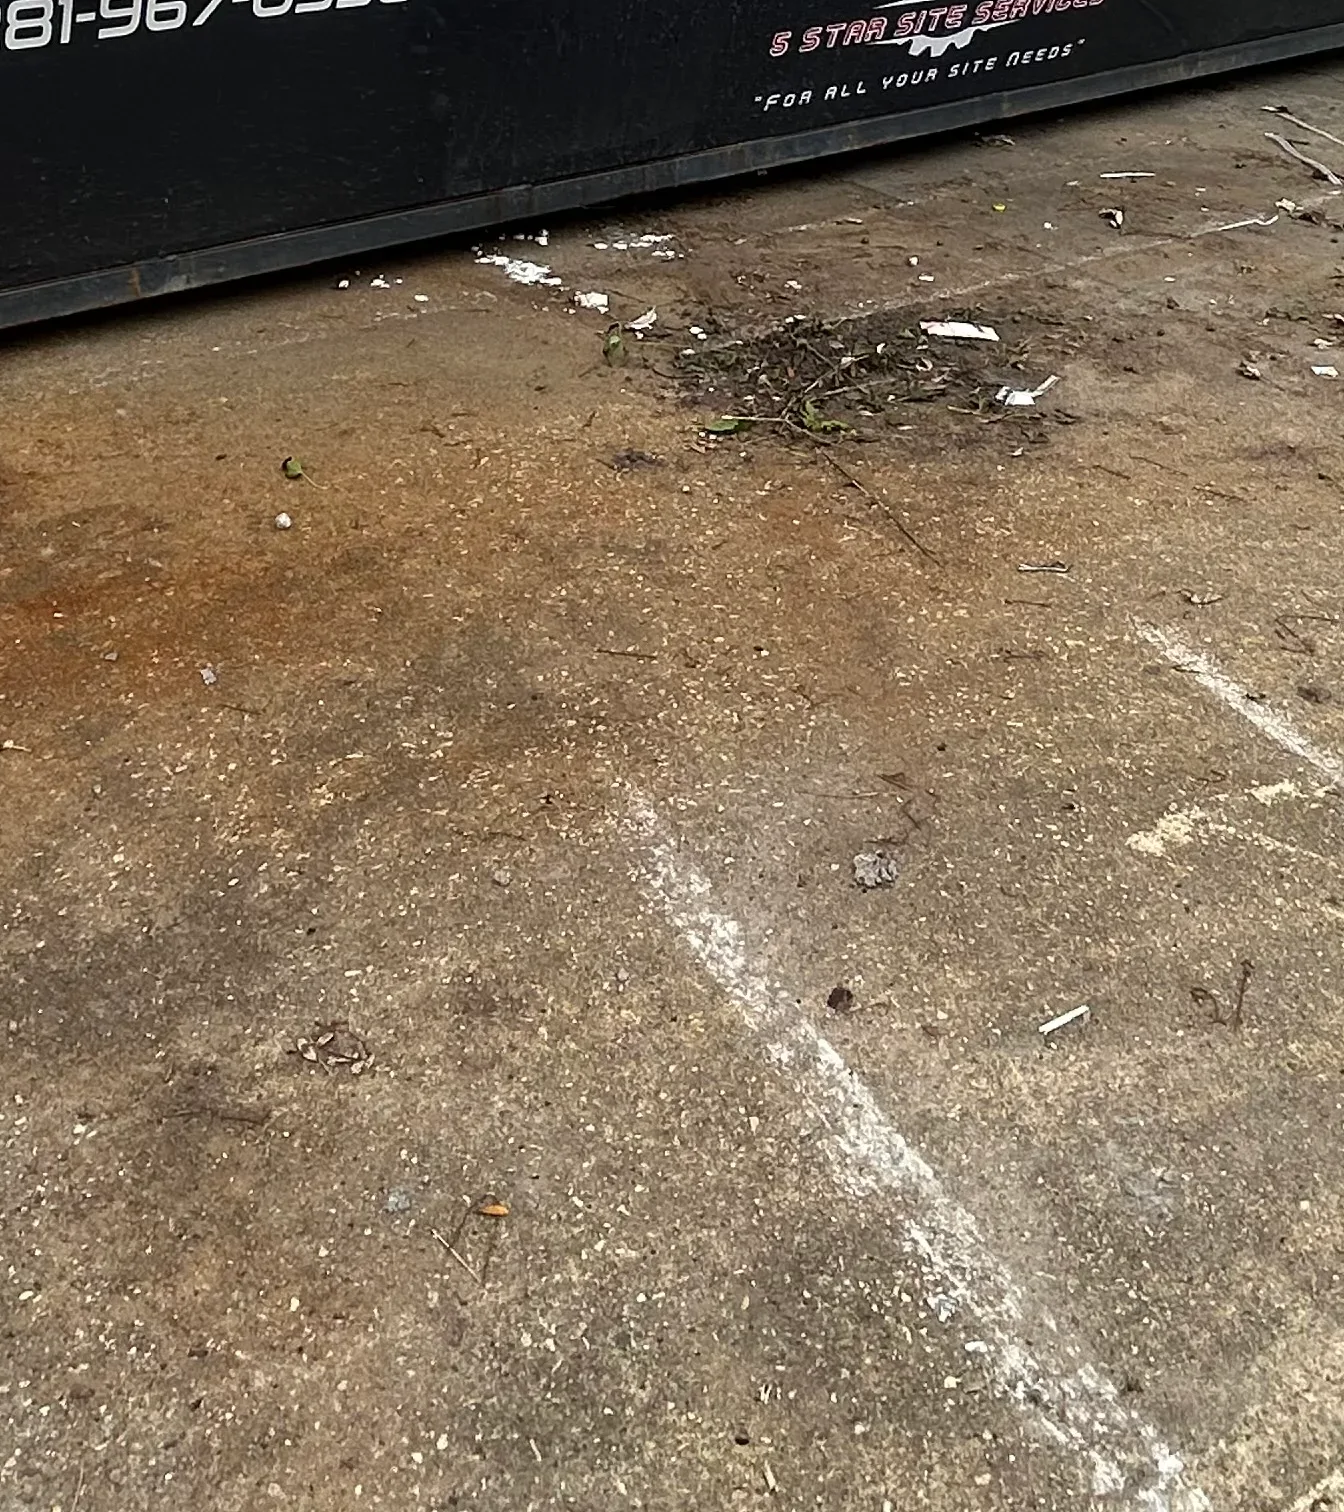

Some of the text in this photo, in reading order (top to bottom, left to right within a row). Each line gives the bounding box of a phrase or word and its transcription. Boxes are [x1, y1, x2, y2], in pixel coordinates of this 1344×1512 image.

[769, 31, 793, 57] 5
[798, 16, 888, 54] STAR
[894, 3, 968, 37] SITE
[824, 80, 867, 102] ALL
[882, 67, 939, 90] YOUR
[948, 56, 998, 77] SITE
